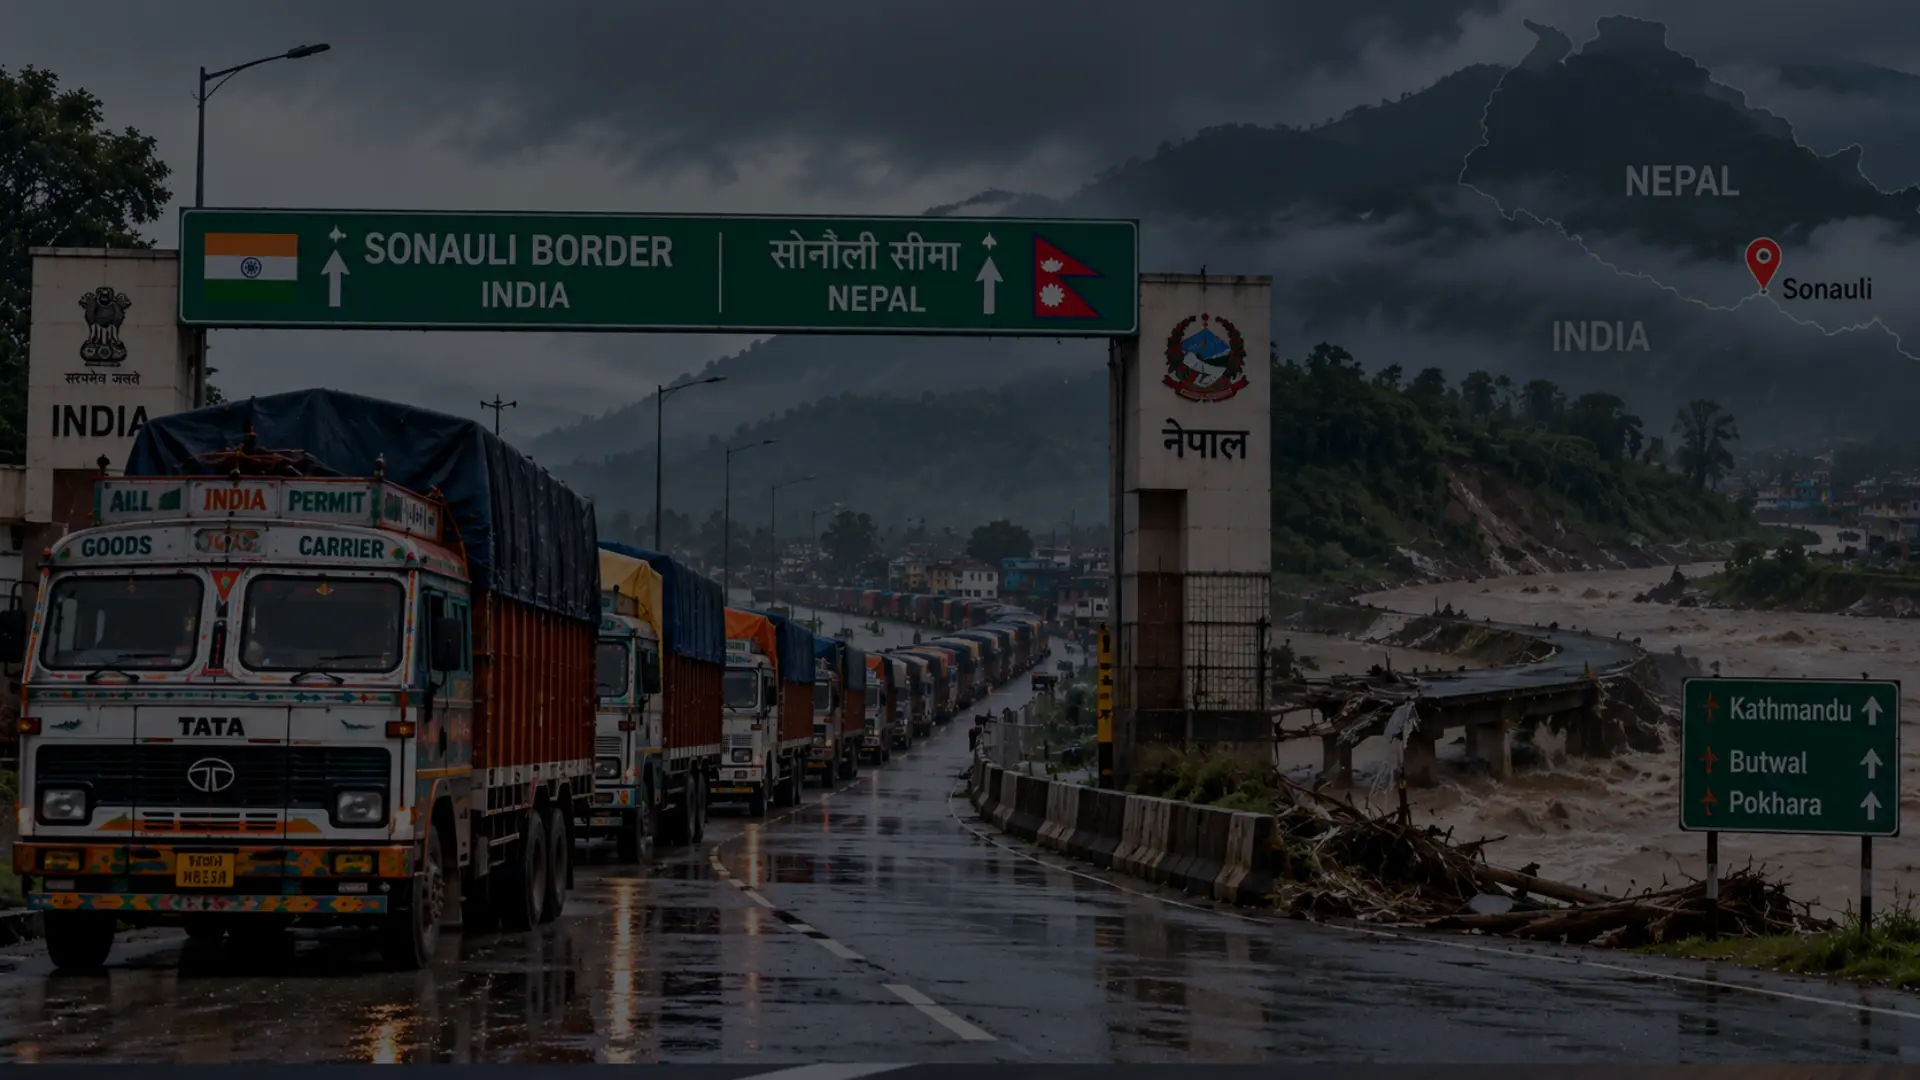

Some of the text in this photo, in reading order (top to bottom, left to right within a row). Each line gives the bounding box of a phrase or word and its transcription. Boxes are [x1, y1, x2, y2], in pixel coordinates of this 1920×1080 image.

[364, 232, 673, 268] SONAULI BORDER
[888, 232, 962, 271] सीमा
[481, 280, 570, 309] INDIA
[828, 284, 927, 313] NEPAL
[53, 404, 148, 437] INDIA
[1161, 417, 1250, 459] नेपाल
[203, 488, 266, 511] INDIA
[289, 490, 367, 514] PERMIT
[81, 535, 385, 559] GOODS CARRIER
[1729, 695, 1853, 722] Kathmandu
[178, 716, 245, 736] TATA
[1729, 749, 1808, 775] Butwal
[1729, 789, 1823, 816] Pokhara
